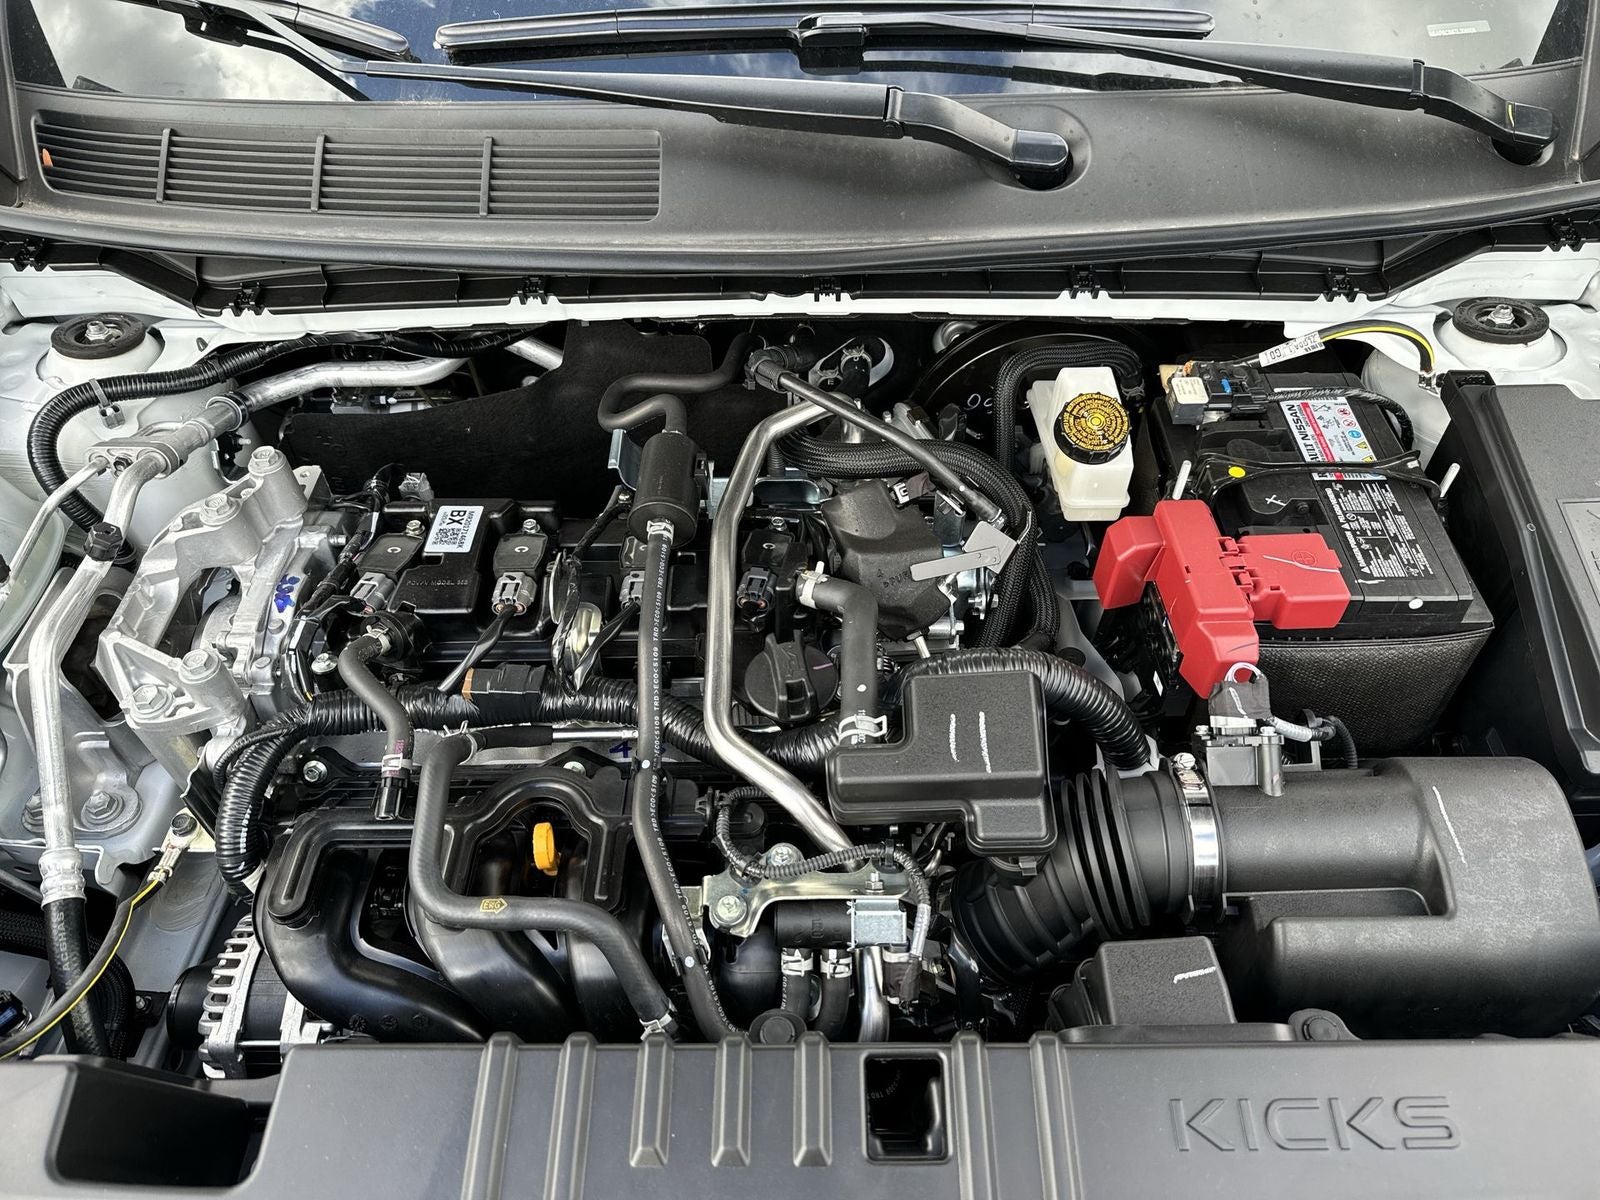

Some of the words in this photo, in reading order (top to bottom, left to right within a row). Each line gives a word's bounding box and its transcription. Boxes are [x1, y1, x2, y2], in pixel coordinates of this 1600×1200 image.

[1285, 404, 1311, 441] NISSAN
[446, 510, 467, 526] BX
[1169, 1096, 1461, 1151] KICKS
